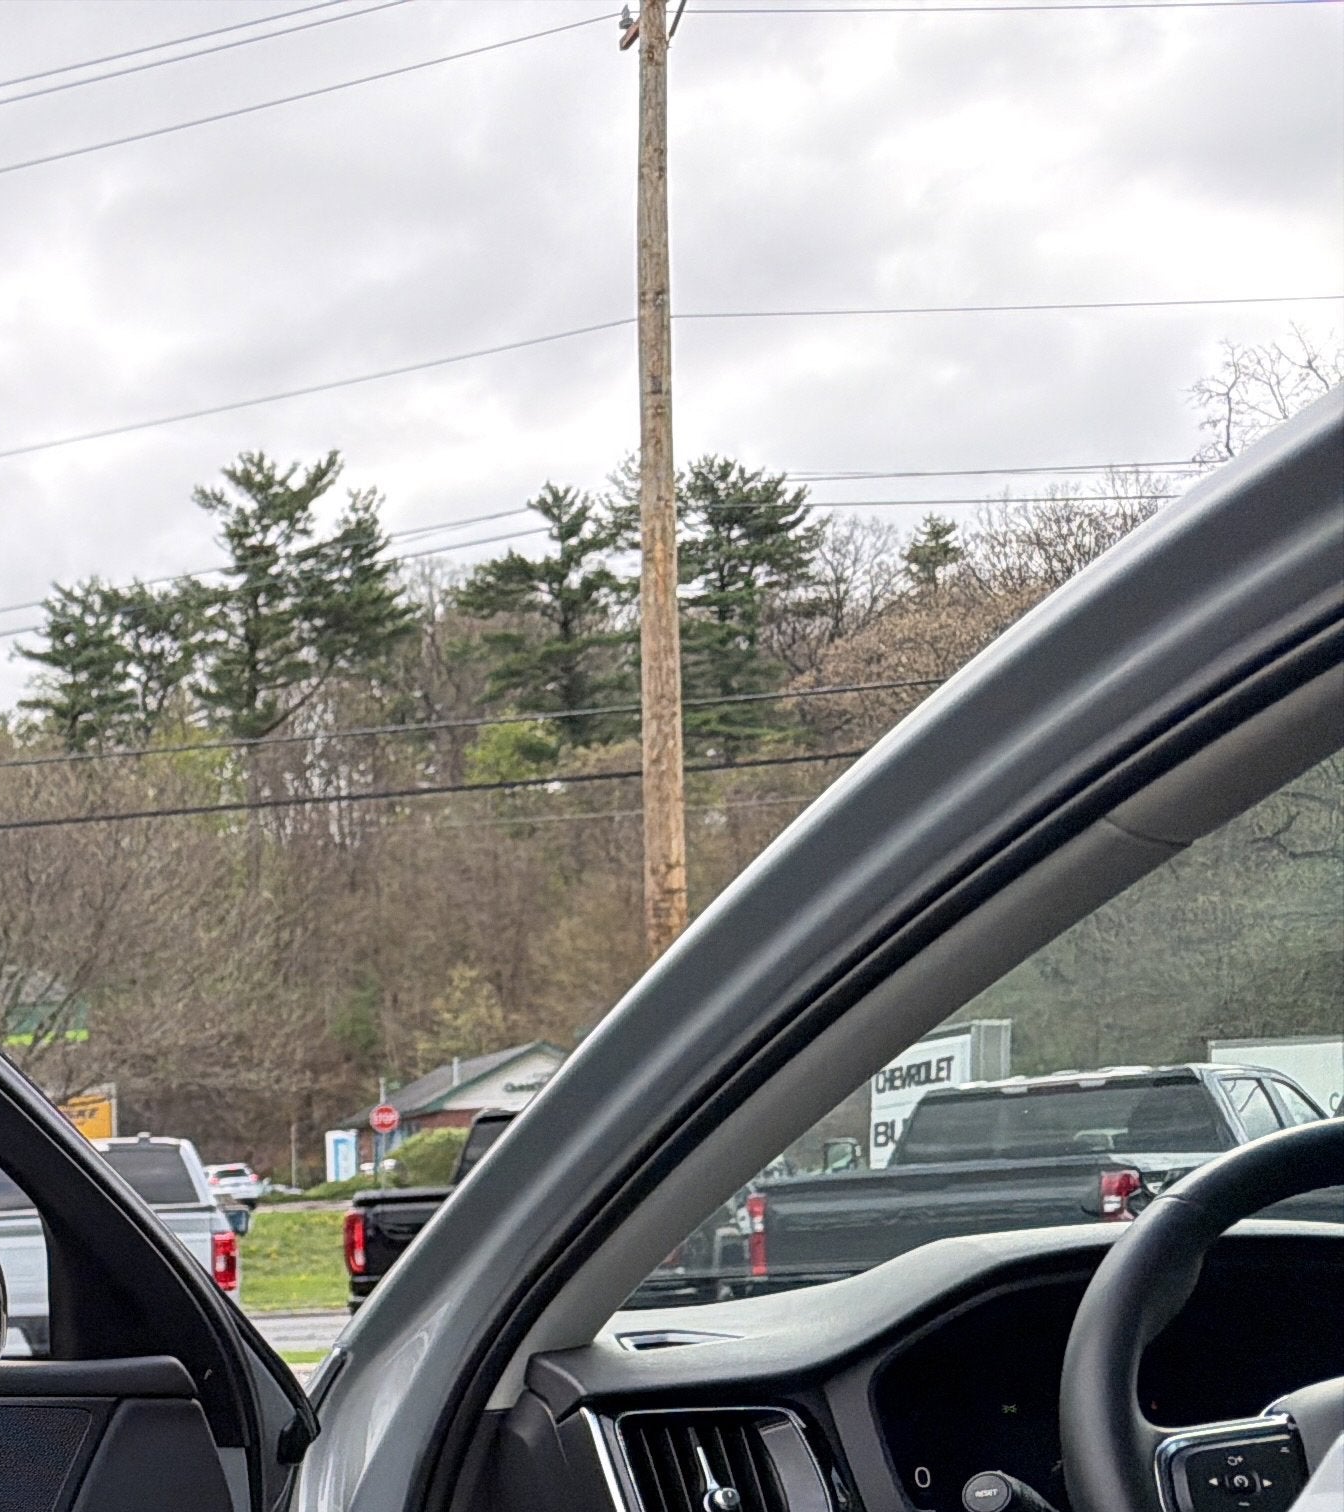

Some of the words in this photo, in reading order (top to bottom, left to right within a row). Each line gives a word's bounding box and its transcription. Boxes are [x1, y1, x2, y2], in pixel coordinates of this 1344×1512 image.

[875, 1056, 954, 1094] CHEVROLET
[914, 1466, 931, 1488] 0
[974, 1488, 999, 1498] RESET
